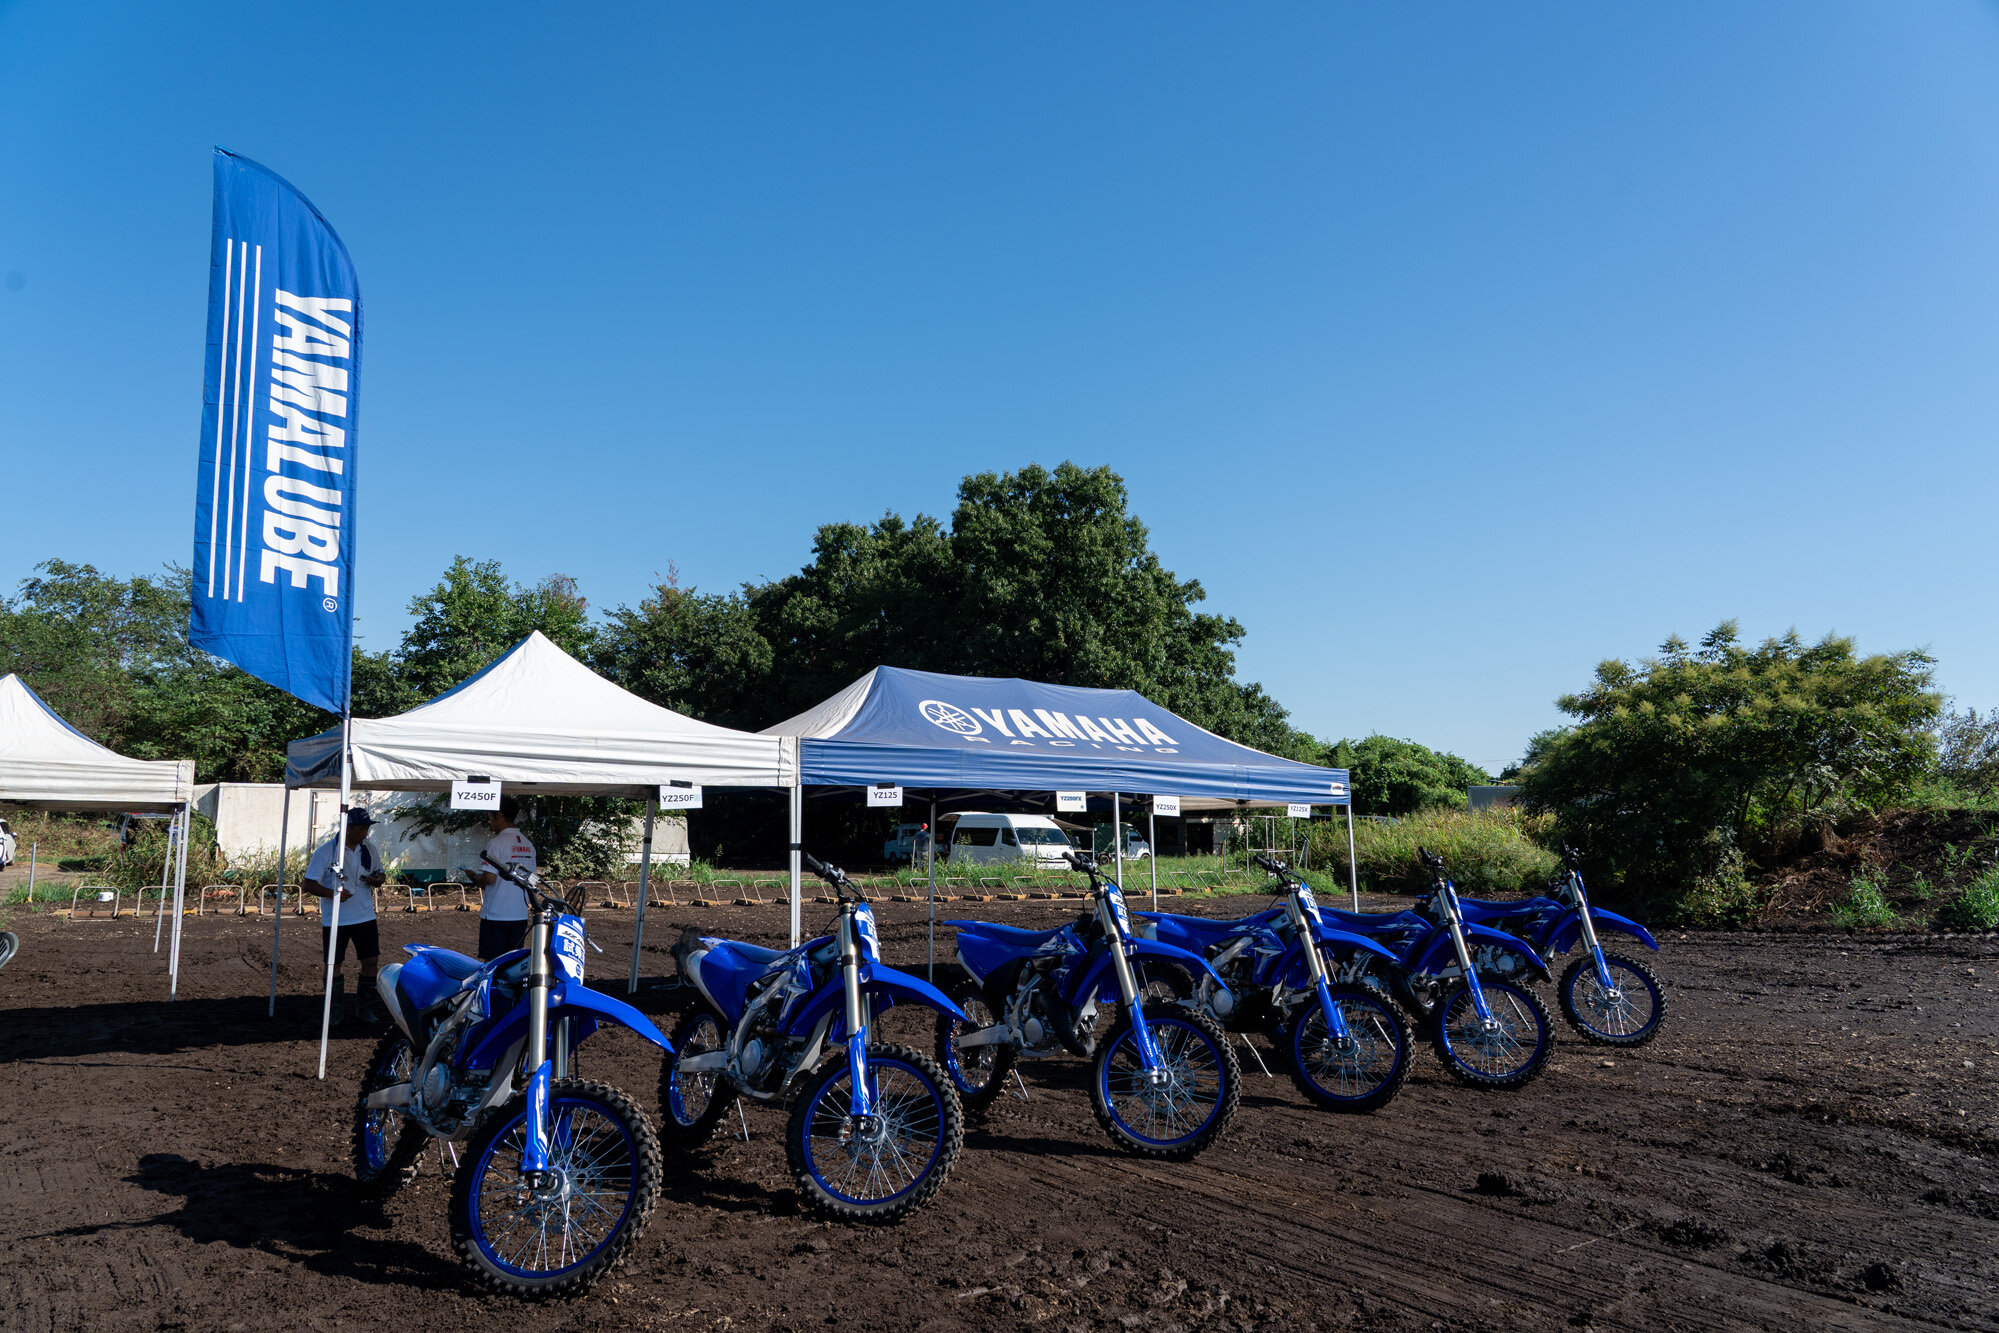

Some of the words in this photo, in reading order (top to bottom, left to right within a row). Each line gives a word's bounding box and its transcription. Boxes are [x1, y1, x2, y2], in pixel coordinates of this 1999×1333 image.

[260, 288, 352, 597] YAMALUBE
[970, 707, 1180, 746] YAMAHA
[962, 735, 1180, 754] RACING
[457, 791, 497, 801] YZ450F
[662, 794, 694, 803] YZ250F
[873, 791, 898, 799] YZ125
[1156, 803, 1177, 811] YZ250X
